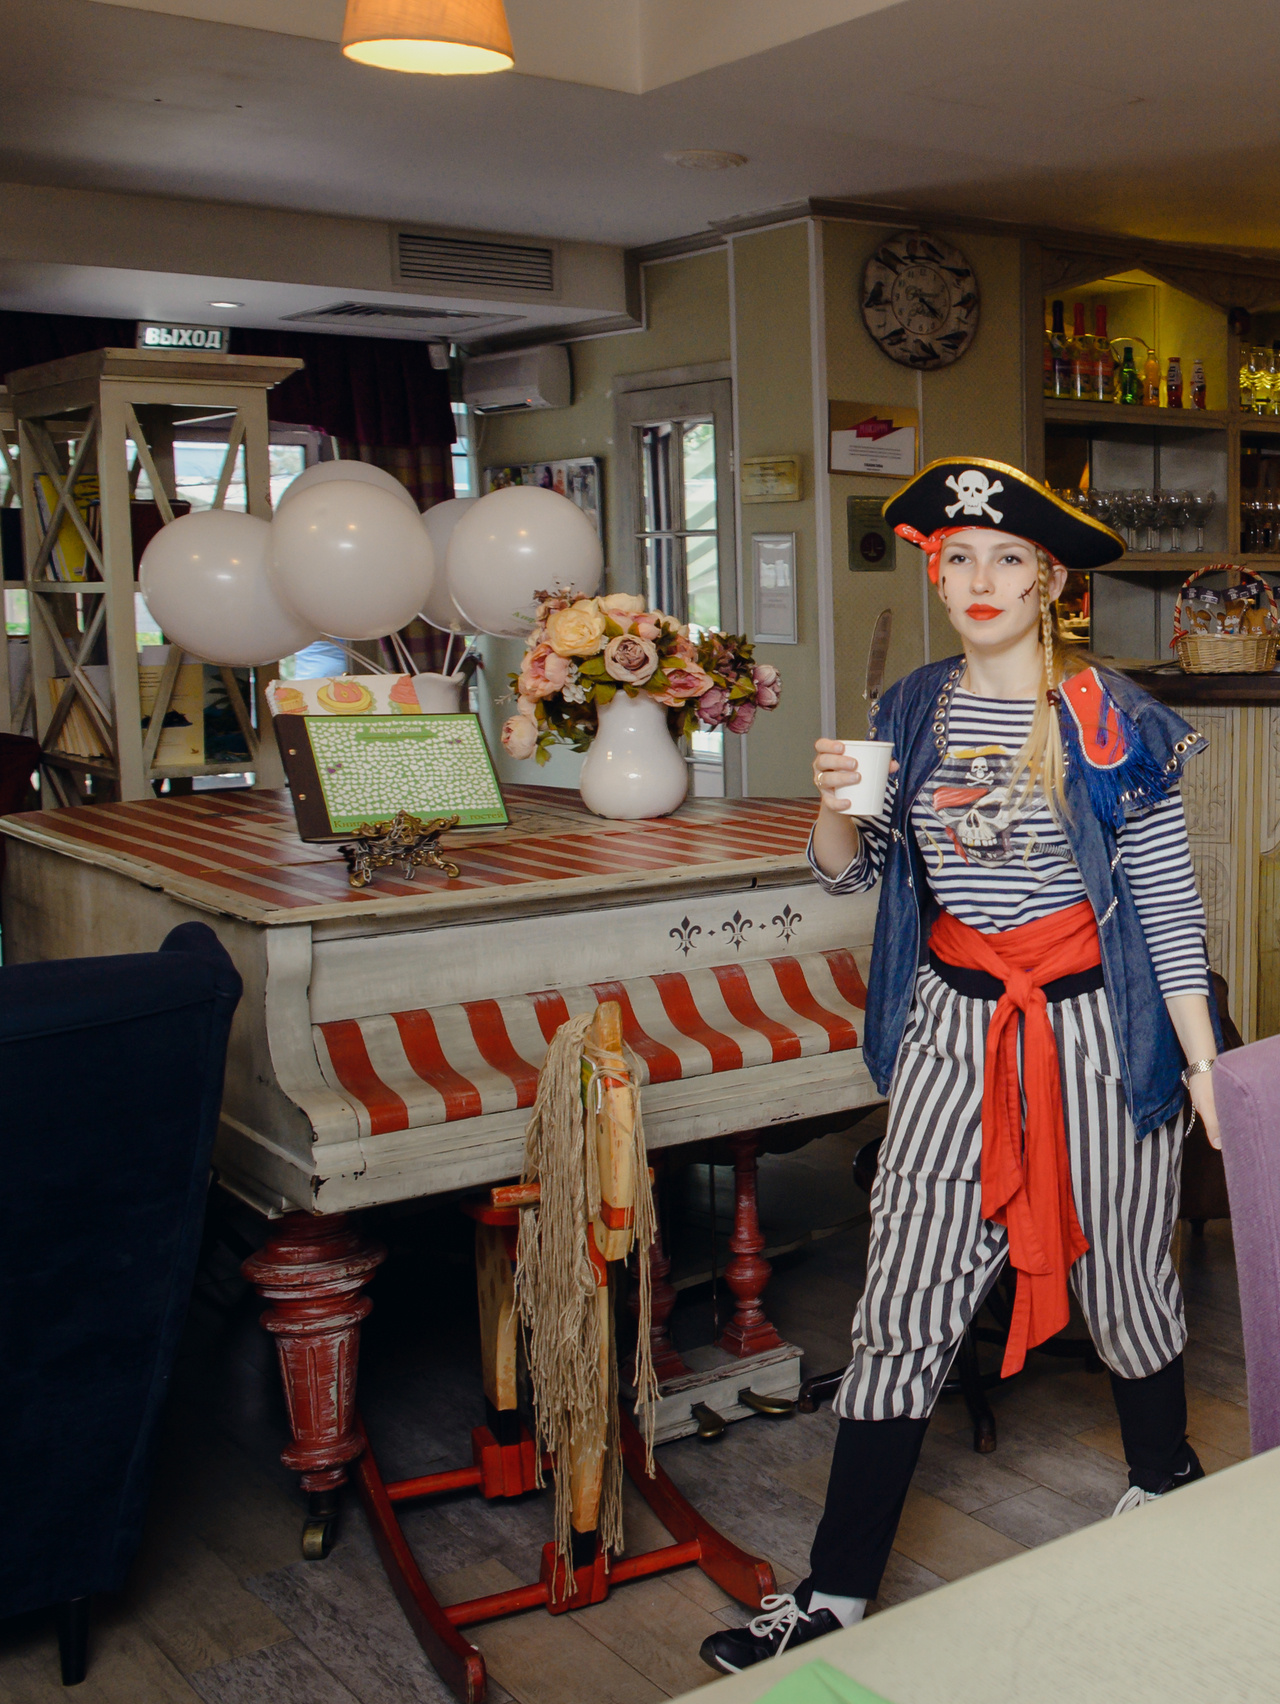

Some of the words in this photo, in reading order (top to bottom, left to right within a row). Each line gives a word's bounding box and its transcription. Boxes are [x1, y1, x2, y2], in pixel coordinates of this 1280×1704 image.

[144, 327, 222, 349] ВЫХОД
[333, 820, 361, 829] Книг
[469, 811, 504, 821] гостей
